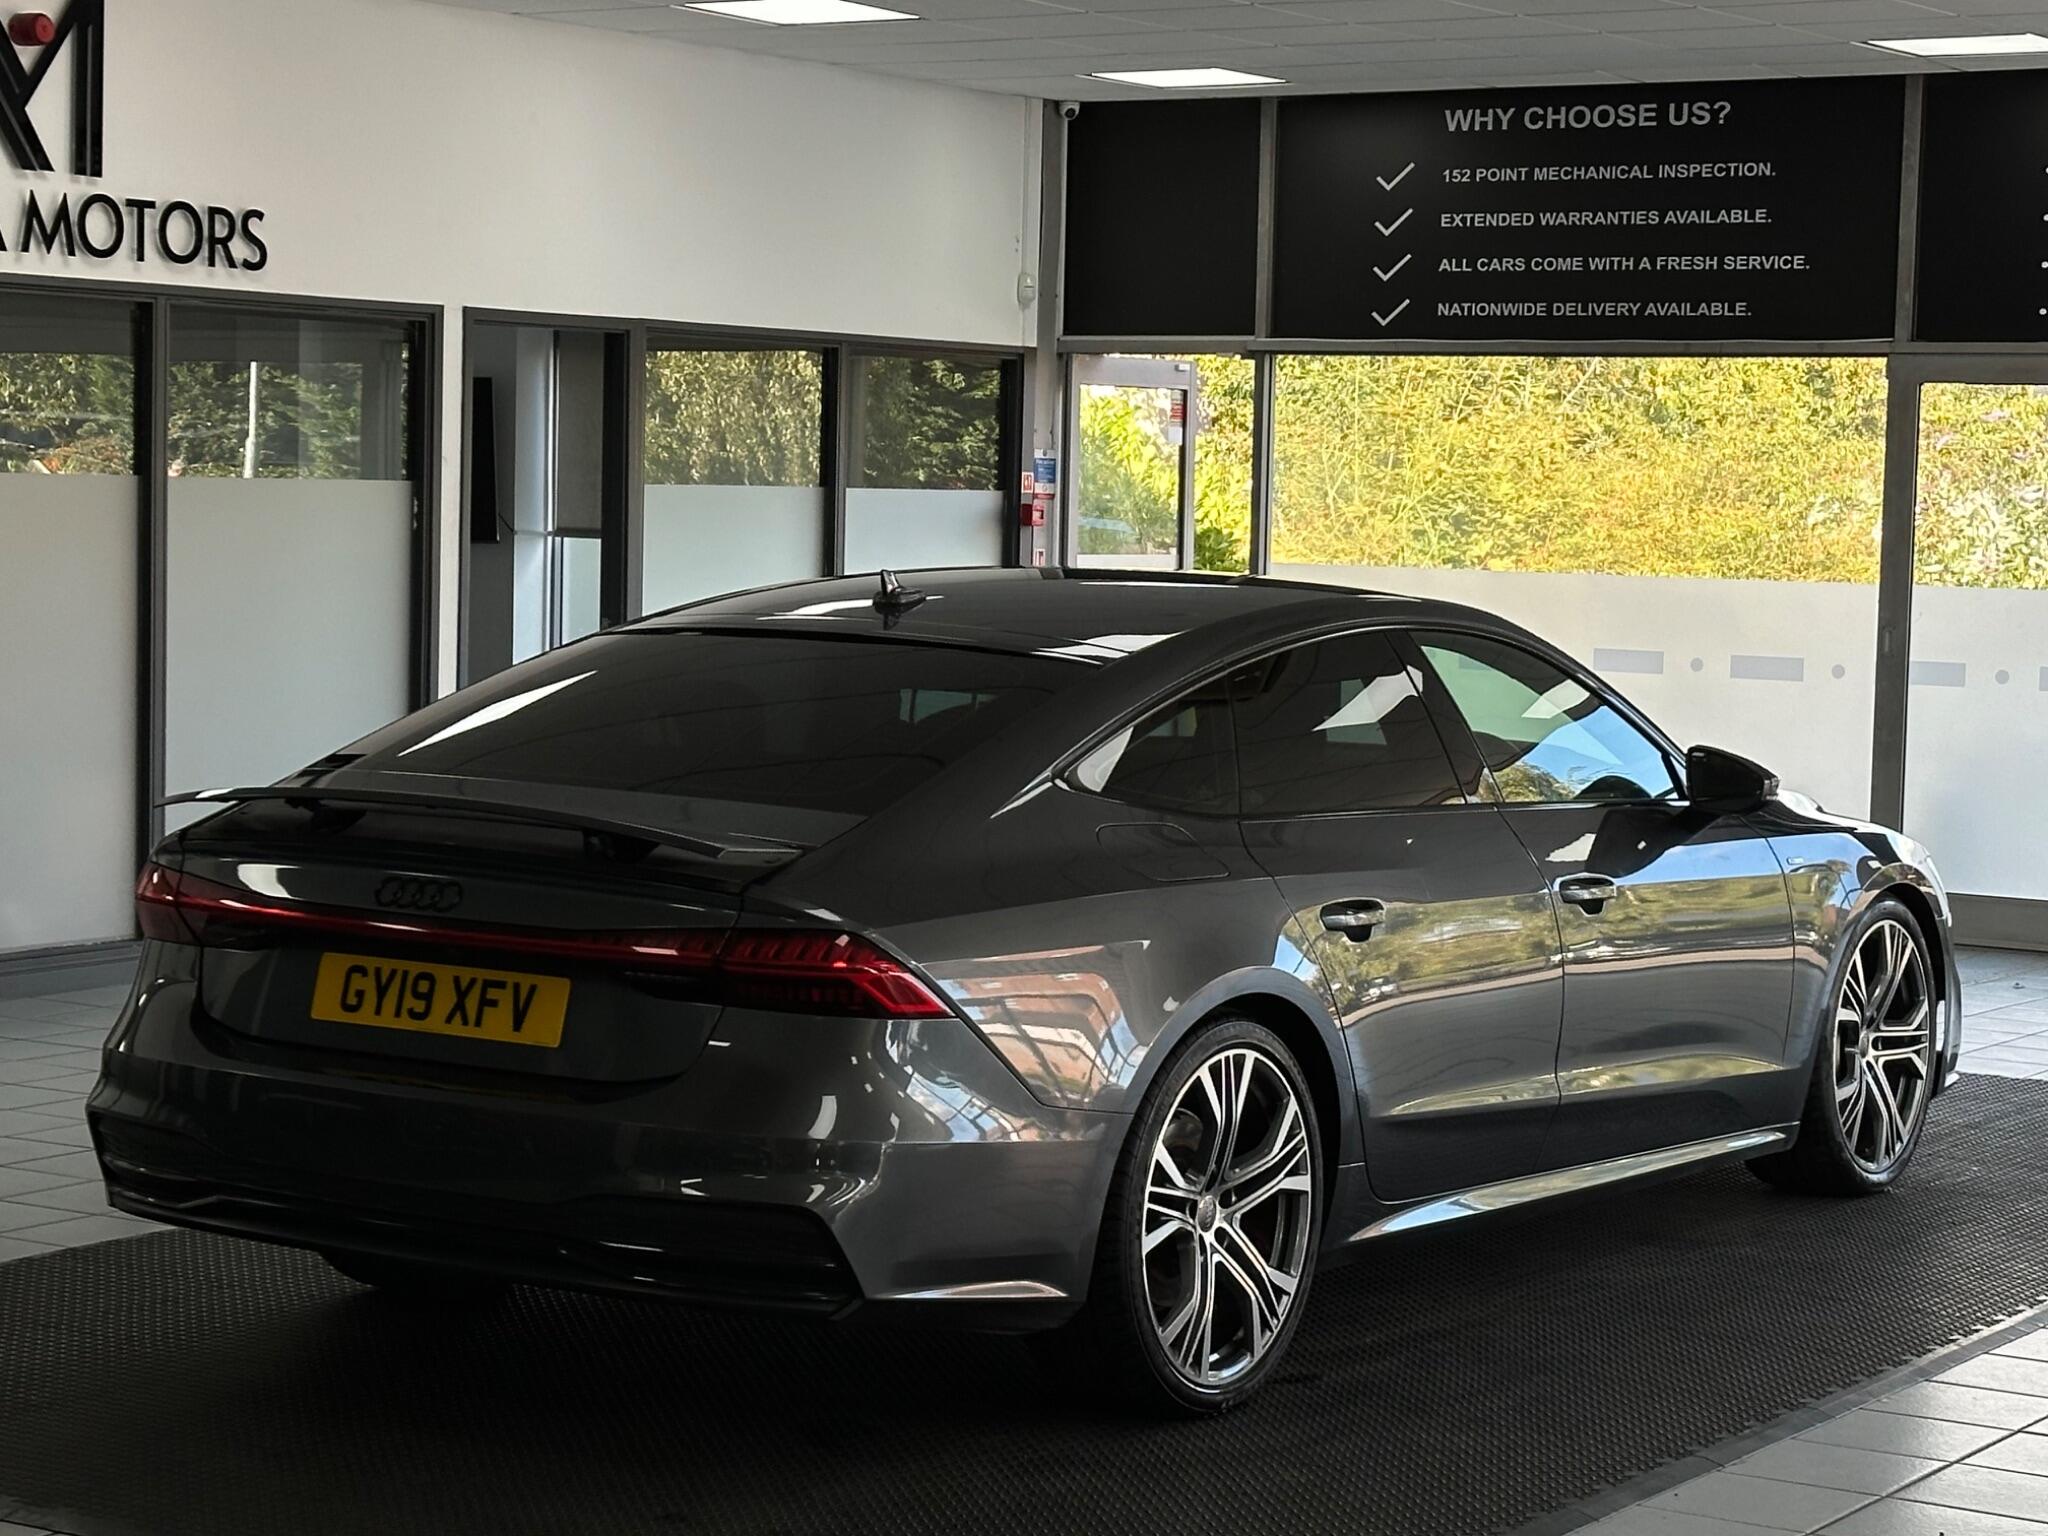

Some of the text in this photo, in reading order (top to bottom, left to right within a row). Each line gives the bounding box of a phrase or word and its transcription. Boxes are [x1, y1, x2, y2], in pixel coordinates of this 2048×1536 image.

[1445, 101, 1733, 131] WHY CHOOSE US?
[1443, 162, 1777, 183] 152 POINT MECHANICAL INSPECTION.
[1440, 209, 1772, 227] EXTENDED WARRANTIES AVAILABLE.
[21, 190, 268, 271] MOTORS
[1438, 255, 1811, 272] ALL CARS COME WITH A FRESH SERVICE.
[1437, 302, 1752, 317] NATIONWIDE DELIVERY AVAILABLE.
[340, 964, 537, 1033] GY19 XFV
